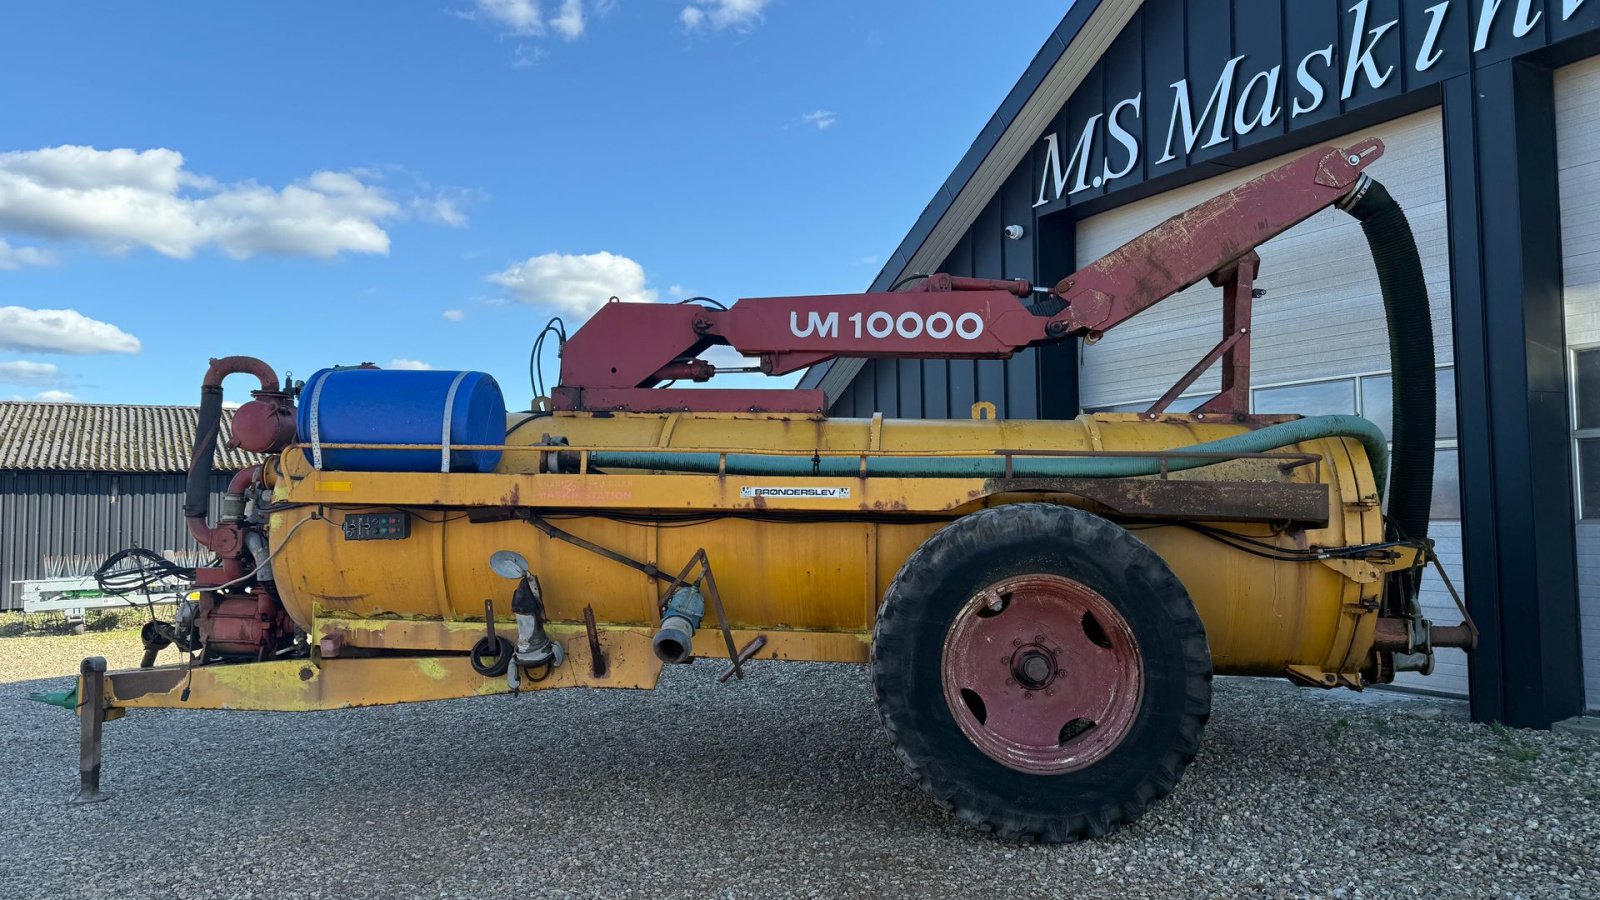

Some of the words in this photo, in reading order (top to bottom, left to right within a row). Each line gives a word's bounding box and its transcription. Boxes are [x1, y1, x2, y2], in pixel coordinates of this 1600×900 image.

[1031, 91, 1142, 208] M.S
[1155, 0, 1586, 166] Maskin
[789, 311, 839, 338] UM
[848, 310, 984, 340] 10000
[754, 488, 836, 496] BRØNDERSLEV
